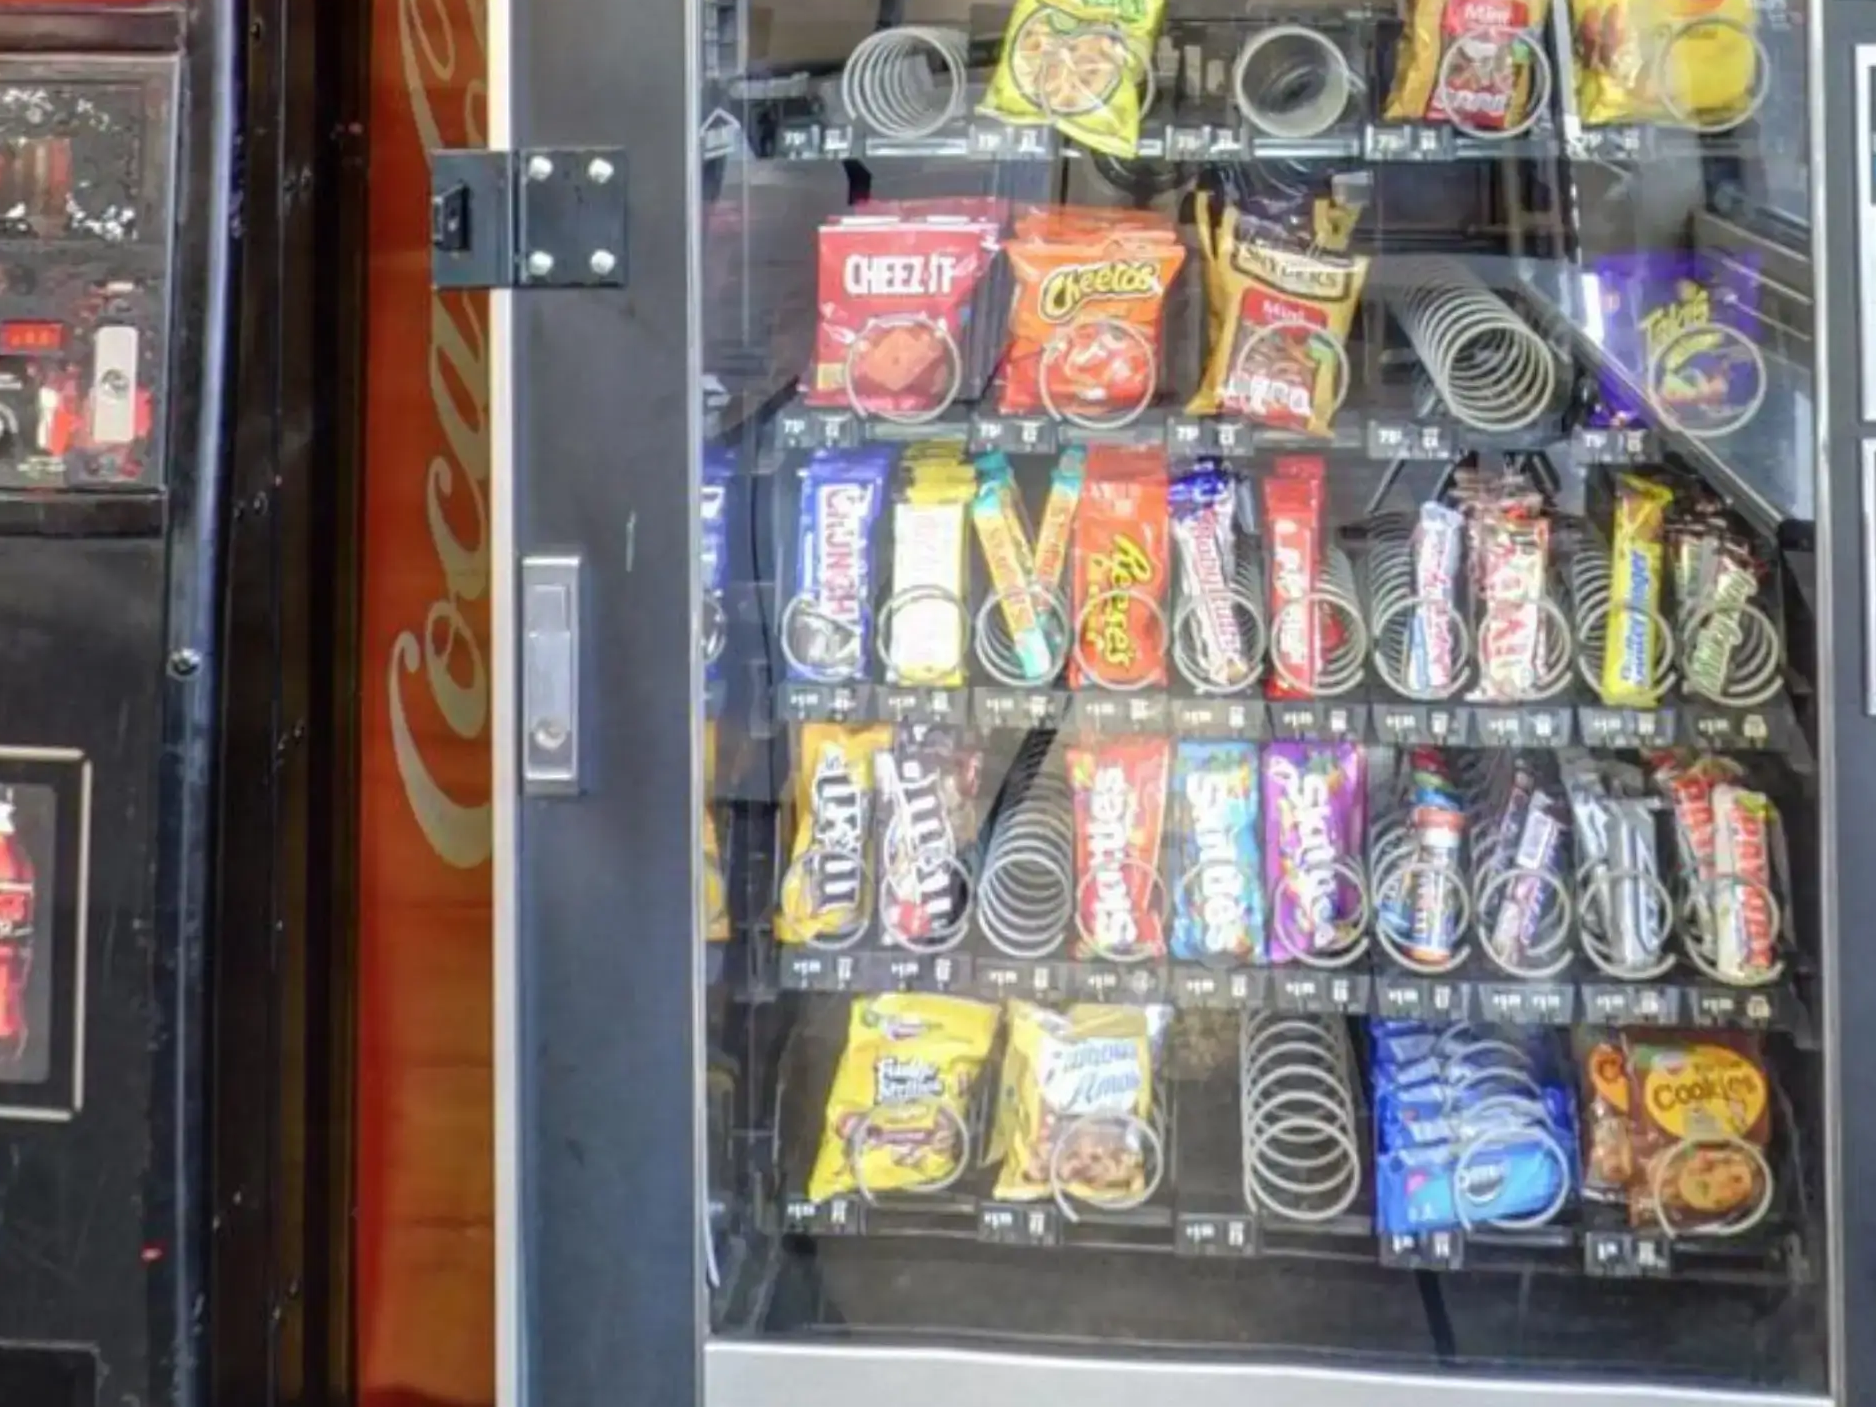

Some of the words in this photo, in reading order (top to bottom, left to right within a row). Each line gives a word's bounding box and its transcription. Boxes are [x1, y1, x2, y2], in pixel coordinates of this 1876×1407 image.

[1040, 262, 1159, 321] Cheetos
[1101, 532, 1155, 671] Reese's
[1654, 1072, 1759, 1113] Cookies
